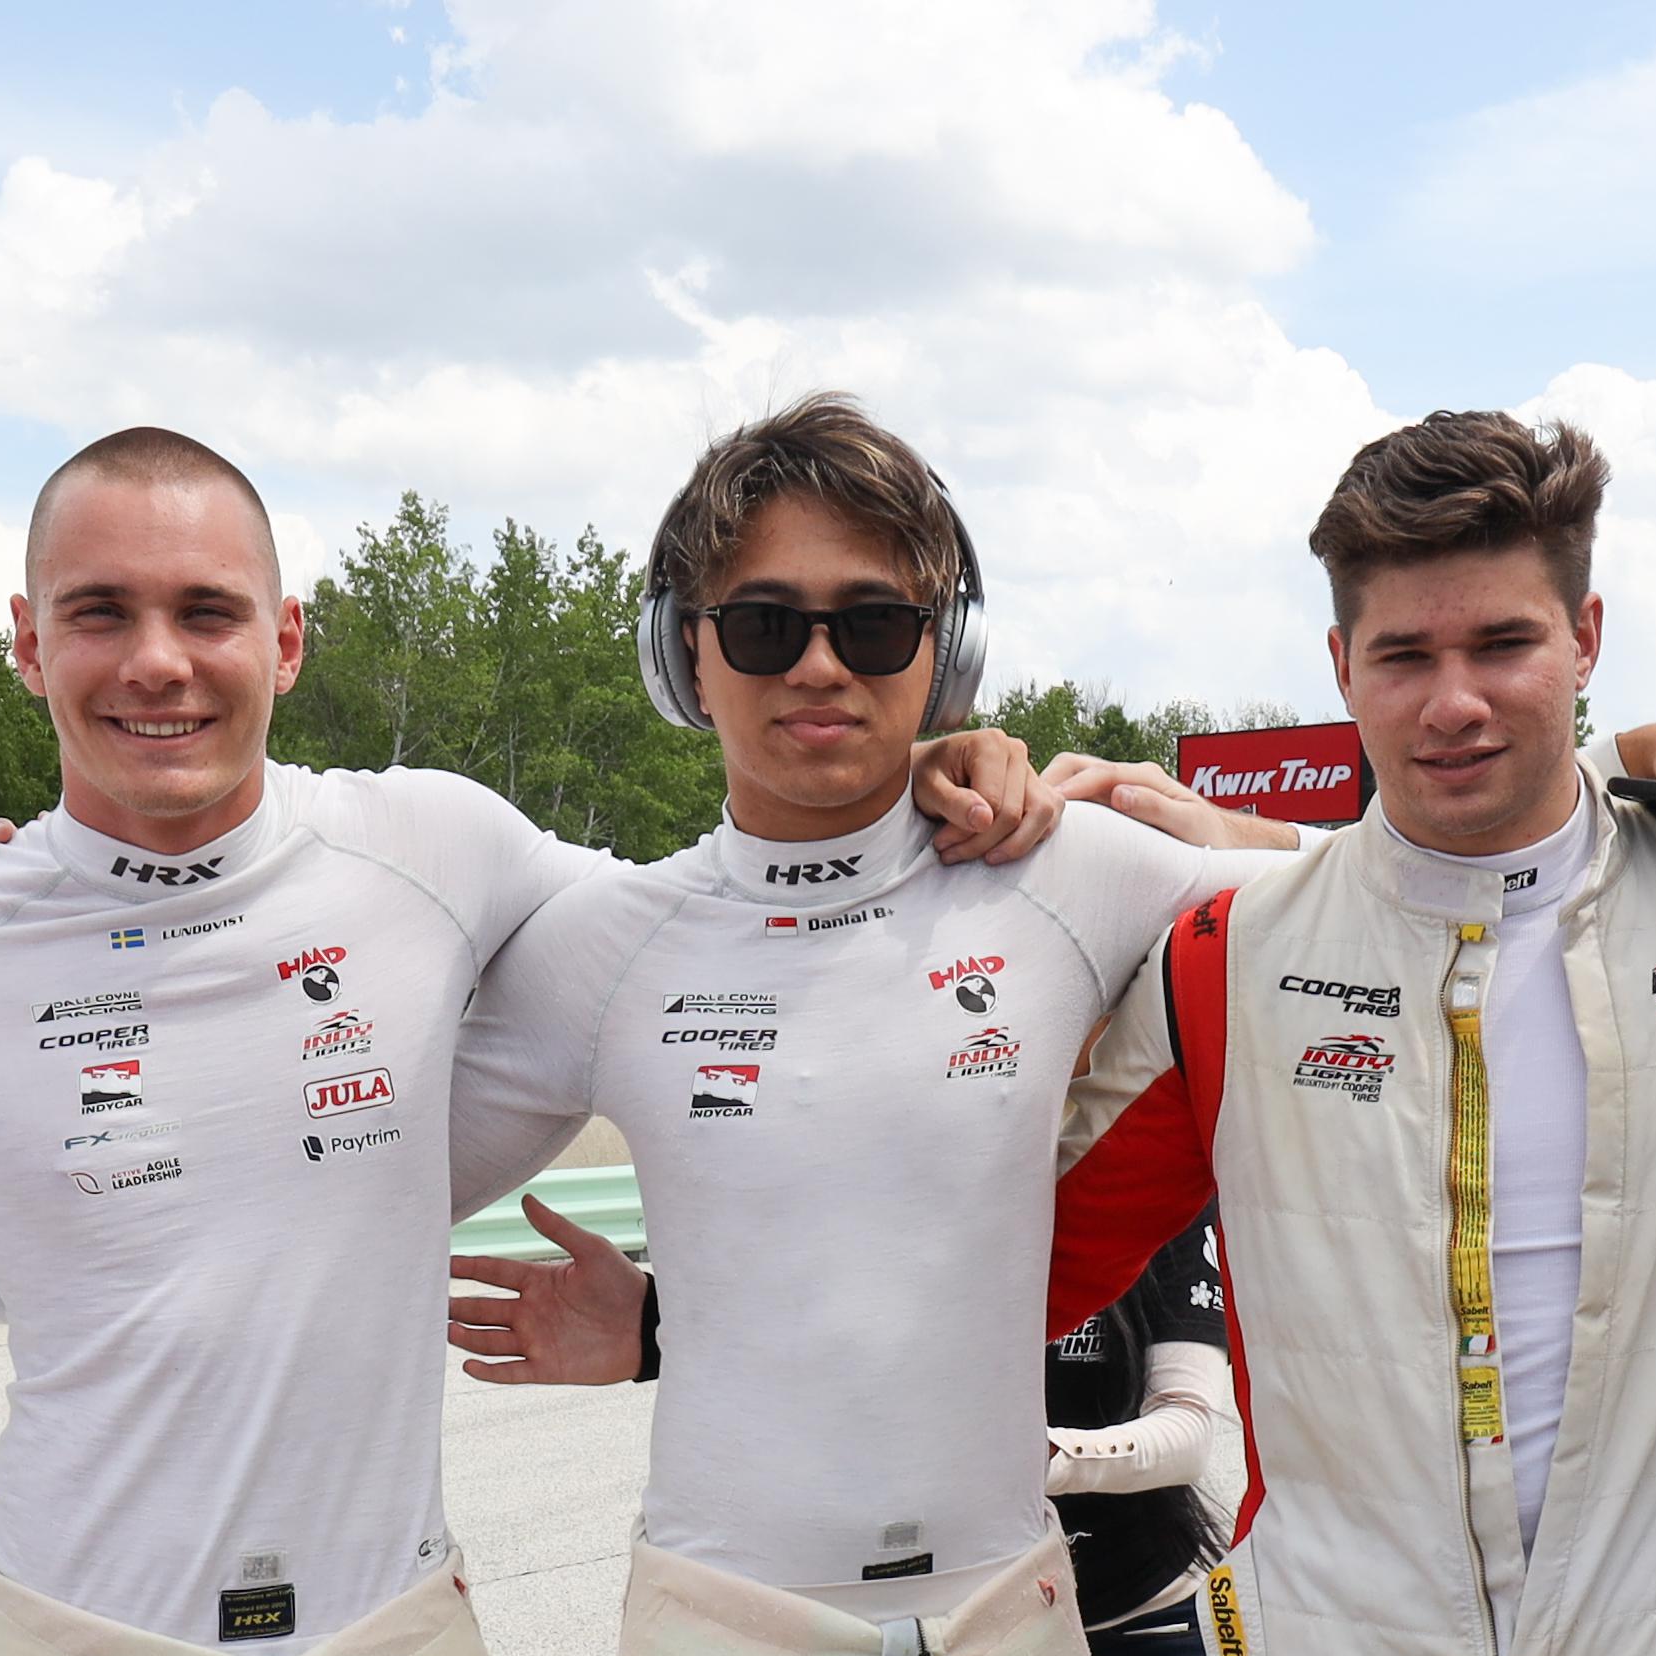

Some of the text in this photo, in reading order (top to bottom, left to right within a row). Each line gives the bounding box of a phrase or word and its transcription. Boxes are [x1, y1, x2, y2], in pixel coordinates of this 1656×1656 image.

[1191, 758, 1352, 797] KWIK TRIP
[110, 855, 225, 886] HRX
[765, 855, 863, 886] HRX
[277, 946, 348, 981] HMD
[928, 955, 1005, 991] HMD
[95, 991, 141, 1002] COYNE
[1279, 975, 1401, 1005] COOPER
[56, 1004, 143, 1020] RACING
[1343, 1000, 1401, 1018] TIRES
[39, 1024, 149, 1049] COOPER
[96, 1036, 150, 1051] TIRES
[303, 1022, 374, 1050] INDY
[661, 1029, 777, 1044] COOPER
[718, 1040, 776, 1051] TIRES
[948, 1043, 1021, 1067] INDY
[1301, 1049, 1396, 1070] INDY
[1295, 1066, 1384, 1084] LIGHTS
[311, 1075, 391, 1111] JULA
[1341, 1082, 1382, 1093] COOPER
[81, 1097, 143, 1115] INDYCAR
[1351, 1092, 1380, 1103] TIRES
[689, 1107, 754, 1119] INDYCAR
[330, 1127, 401, 1154] Paytrim
[146, 1157, 181, 1173] AGILE
[112, 1168, 183, 1190] LEADERSHIP
[1461, 1307, 1489, 1316] Sabelt
[234, 1611, 281, 1627] HRX
